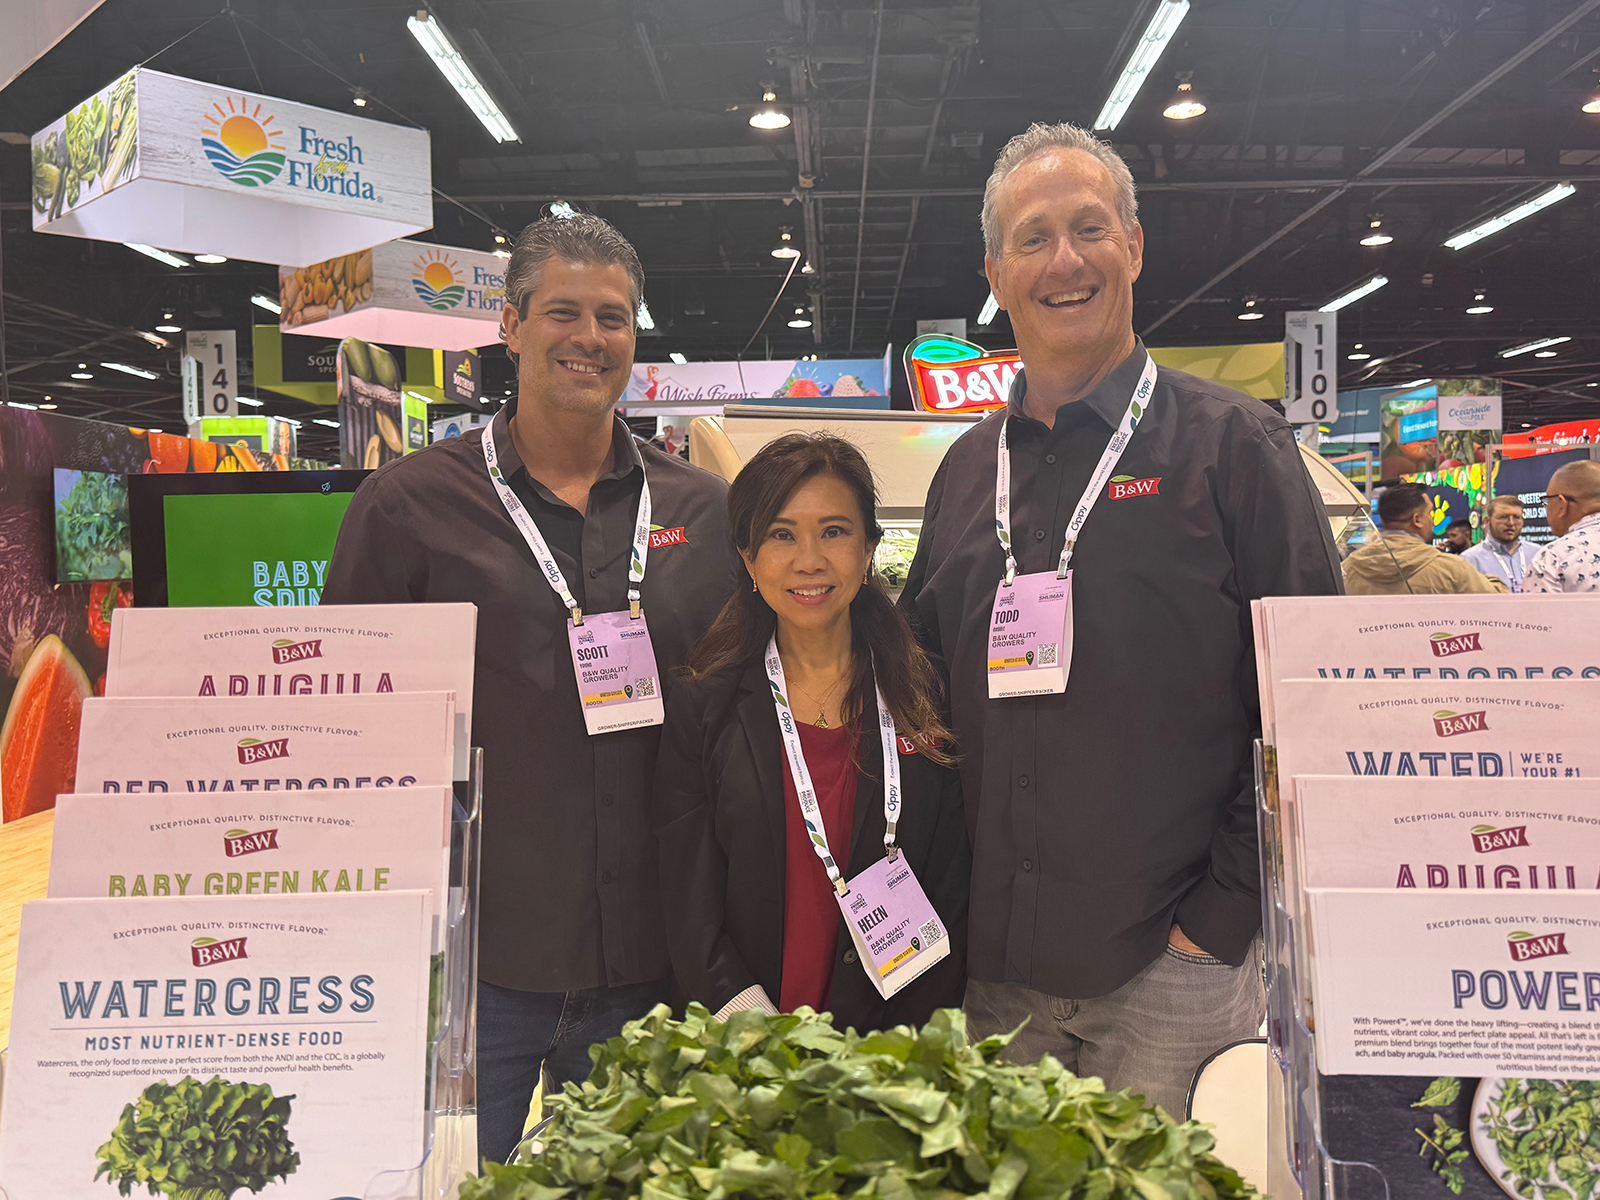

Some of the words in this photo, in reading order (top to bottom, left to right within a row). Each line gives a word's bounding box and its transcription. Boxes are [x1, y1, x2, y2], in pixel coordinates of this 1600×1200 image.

[298, 126, 364, 164] Fresh
[314, 153, 350, 182] from
[1312, 324, 1327, 420] 1100
[660, 384, 703, 400] Wish
[708, 384, 758, 400] Farms
[929, 362, 1024, 408] B&W
[1137, 377, 1151, 398] Oppy
[1449, 404, 1491, 418] Oceanside
[1115, 480, 1154, 498] B&W
[1071, 505, 1087, 531] Oppy
[651, 530, 680, 546] B&W
[253, 561, 327, 587] BABY
[544, 559, 560, 583] Oppy
[995, 609, 1019, 624] TODD
[204, 628, 260, 640] EXCEPTIONAL
[305, 626, 354, 635] DISTINCTIVE
[1359, 622, 1415, 633] EXCEPTIONAL
[1460, 620, 1512, 628] DISTINCTIVE
[992, 639, 1025, 648] GROWERS
[1437, 636, 1474, 656] B&W
[278, 643, 316, 663] B&W
[577, 645, 609, 661] SCOTT
[582, 669, 598, 677] B&W
[600, 666, 628, 674] QUALITY
[583, 673, 618, 683] GROWERS
[1359, 699, 1418, 710] EXCEPTIONAL
[1421, 697, 1462, 705] QUALITY.
[1466, 697, 1520, 706] DISTINCTIVE
[167, 727, 225, 739] EXCEPTIONAL
[228, 724, 268, 733] QUALITY.
[271, 725, 323, 734] DISTINCTIVE
[782, 711, 793, 734] Oppy
[1441, 714, 1481, 736] B&W
[243, 741, 283, 763] B&W
[1521, 752, 1563, 764] WE'RE
[1521, 768, 1558, 778] YOUR
[1565, 768, 1580, 778] #1
[888, 784, 899, 812] Oppy
[150, 818, 210, 831] EXCEPTIONAL
[214, 815, 255, 824] QUALITY.
[259, 815, 313, 823] DISTINCTIVE
[1394, 813, 1456, 824] EXCEPTIONAL
[1459, 811, 1501, 819] QUALITY.
[1505, 811, 1563, 821] DISTINCTIVE
[230, 832, 272, 856] B&W
[1478, 829, 1521, 851] B&W
[109, 873, 192, 897] BABY
[204, 871, 299, 896] GREEN
[312, 868, 390, 893] KALE
[1396, 864, 1600, 889] ARUGUL
[857, 905, 888, 934] HELEN
[1426, 917, 1491, 930] EXCEPTIONAL
[113, 925, 177, 939] EXCEPTIONAL
[181, 922, 224, 931] QUALITY.
[228, 922, 285, 931] DISTINCTIVE
[870, 936, 885, 950] B&W
[886, 918, 911, 939] QUALITY
[874, 931, 905, 955] GROWERS
[1515, 936, 1559, 960] B&W
[197, 941, 241, 965] B&W
[59, 974, 375, 1019] WATERCRESS
[1451, 969, 1600, 1012] POWER
[1353, 1017, 1370, 1025] With
[1471, 1020, 1494, 1028] heavy
[85, 1036, 132, 1050] MOST
[140, 1032, 290, 1050] NUTRIENT-DENSE
[299, 1031, 343, 1046] FOOD
[1459, 1030, 1485, 1038] perfect
[1551, 1032, 1572, 1040] that's
[1414, 1040, 1437, 1048] brings
[1440, 1041, 1471, 1049] together
[1473, 1041, 1488, 1049] four
[1537, 1043, 1562, 1051] potent
[1565, 1043, 1583, 1052] leafy
[95, 1059, 111, 1067] only
[175, 1057, 201, 1065] perfect
[224, 1054, 241, 1062] from
[243, 1054, 260, 1062] both
[262, 1054, 274, 1062] the
[296, 1053, 309, 1061] and
[311, 1053, 323, 1061] the
[357, 1052, 385, 1061] globally
[1387, 1051, 1405, 1059] baby
[1439, 1051, 1464, 1059] Packed
[1563, 1054, 1595, 1062] minerals
[69, 1069, 110, 1078] recognized
[112, 1067, 150, 1077] superfood
[152, 1067, 177, 1075] known
[201, 1066, 228, 1074] distinct
[249, 1065, 263, 1073] and
[264, 1065, 296, 1074] powerful
[1535, 1064, 1556, 1072] blend
